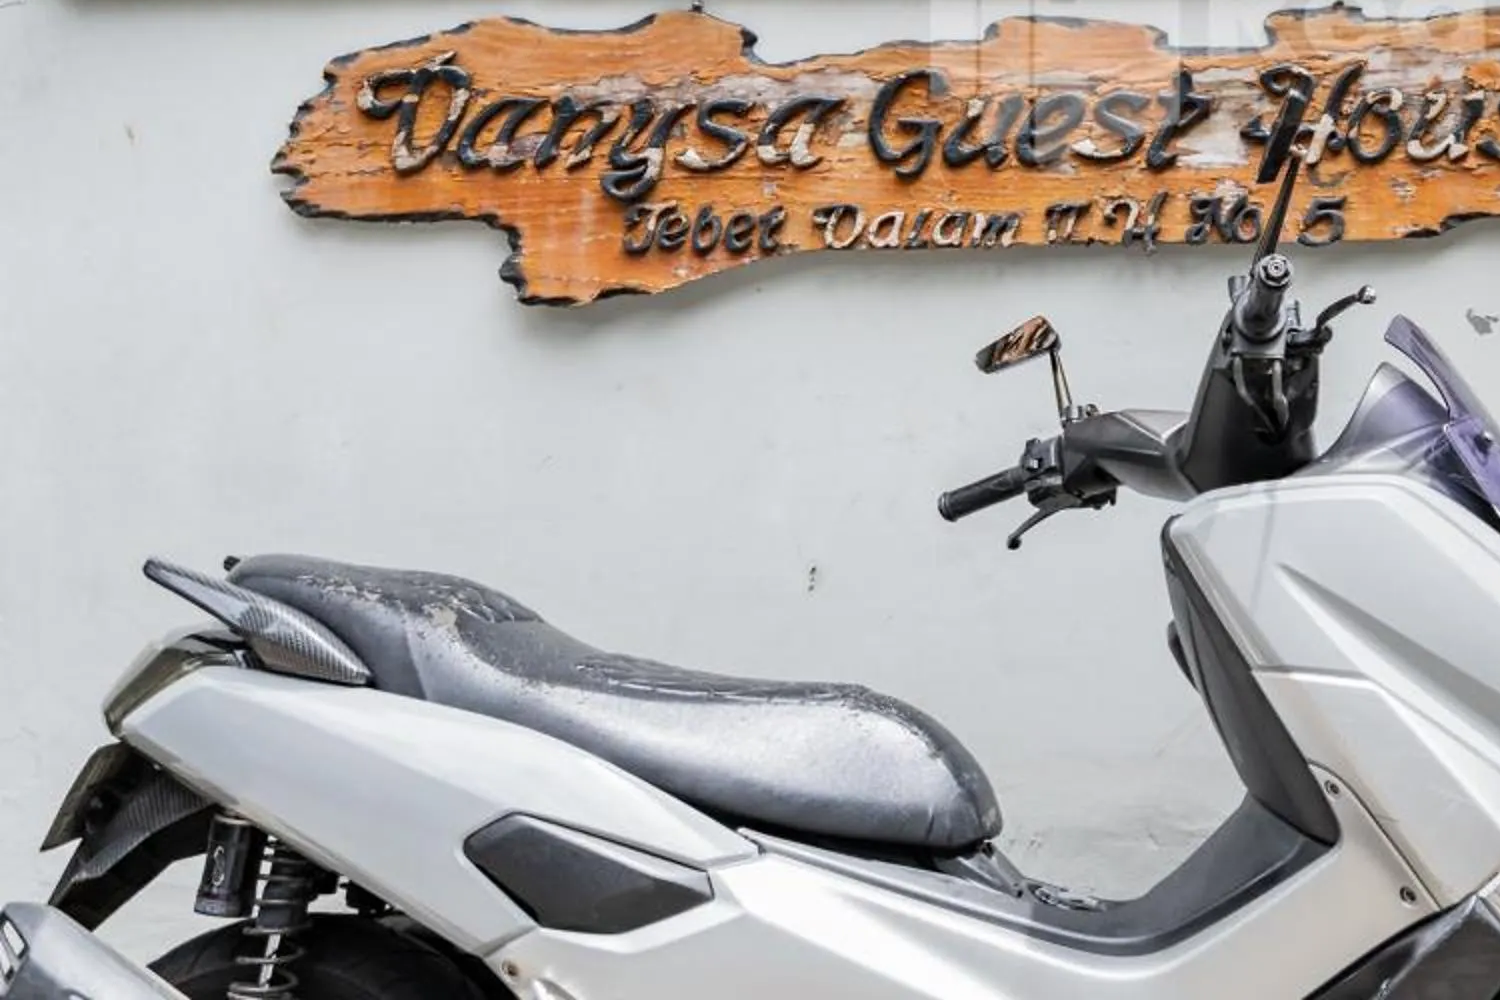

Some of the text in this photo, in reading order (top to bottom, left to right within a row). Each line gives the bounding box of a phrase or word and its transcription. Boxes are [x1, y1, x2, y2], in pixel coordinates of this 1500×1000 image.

[356, 50, 847, 202] Danysa
[867, 69, 1213, 180] Guest
[621, 201, 788, 255] Tebet
[1296, 195, 1348, 247] 5
